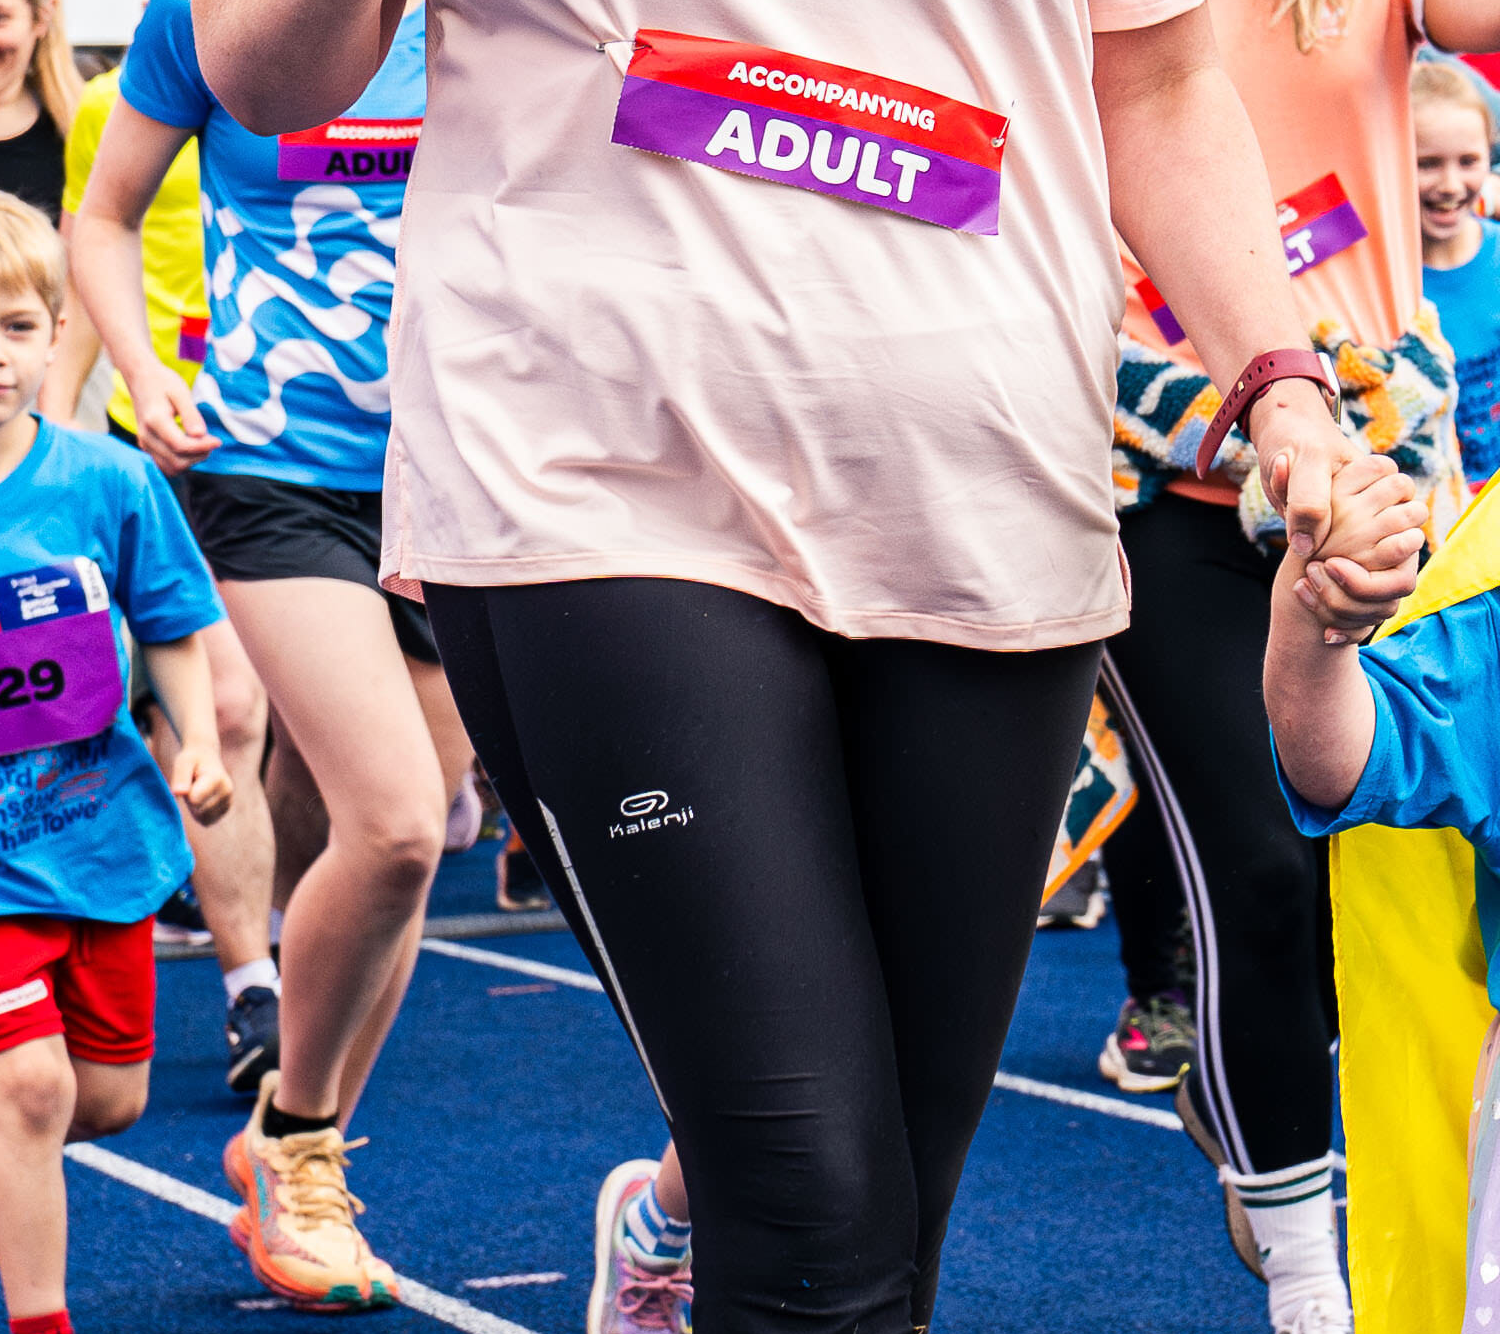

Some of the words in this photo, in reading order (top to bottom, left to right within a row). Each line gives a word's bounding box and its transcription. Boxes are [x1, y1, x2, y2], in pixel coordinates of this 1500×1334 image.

[727, 61, 936, 132] ACCOMPANYING
[704, 108, 931, 204] ADULT
[608, 806, 695, 839] Kalenji
